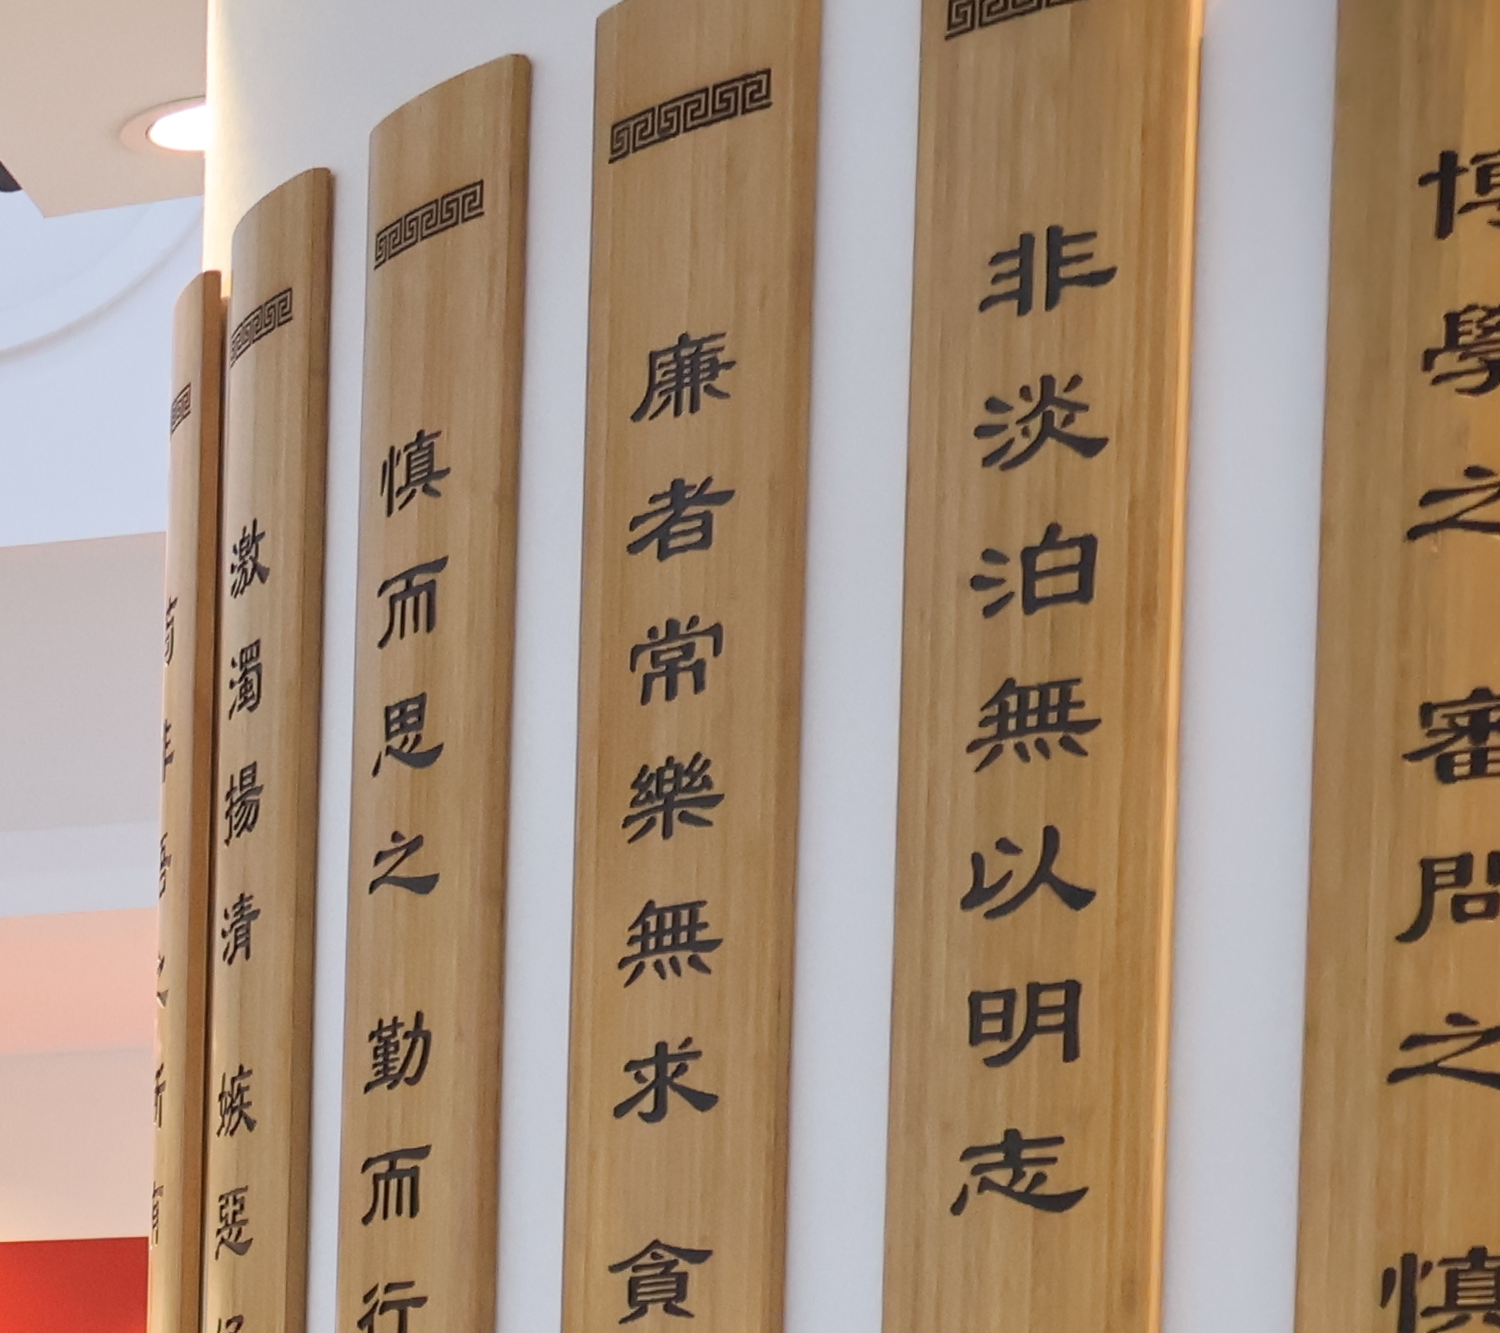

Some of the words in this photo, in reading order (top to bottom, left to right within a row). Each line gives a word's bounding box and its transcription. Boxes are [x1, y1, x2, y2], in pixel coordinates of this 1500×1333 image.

[220, 518, 270, 967] 激濁揚清
[369, 430, 450, 894] 慎而思之
[613, 332, 737, 1124] 廉者常樂無求
[950, 225, 1117, 1216] 非淡泊無以明志
